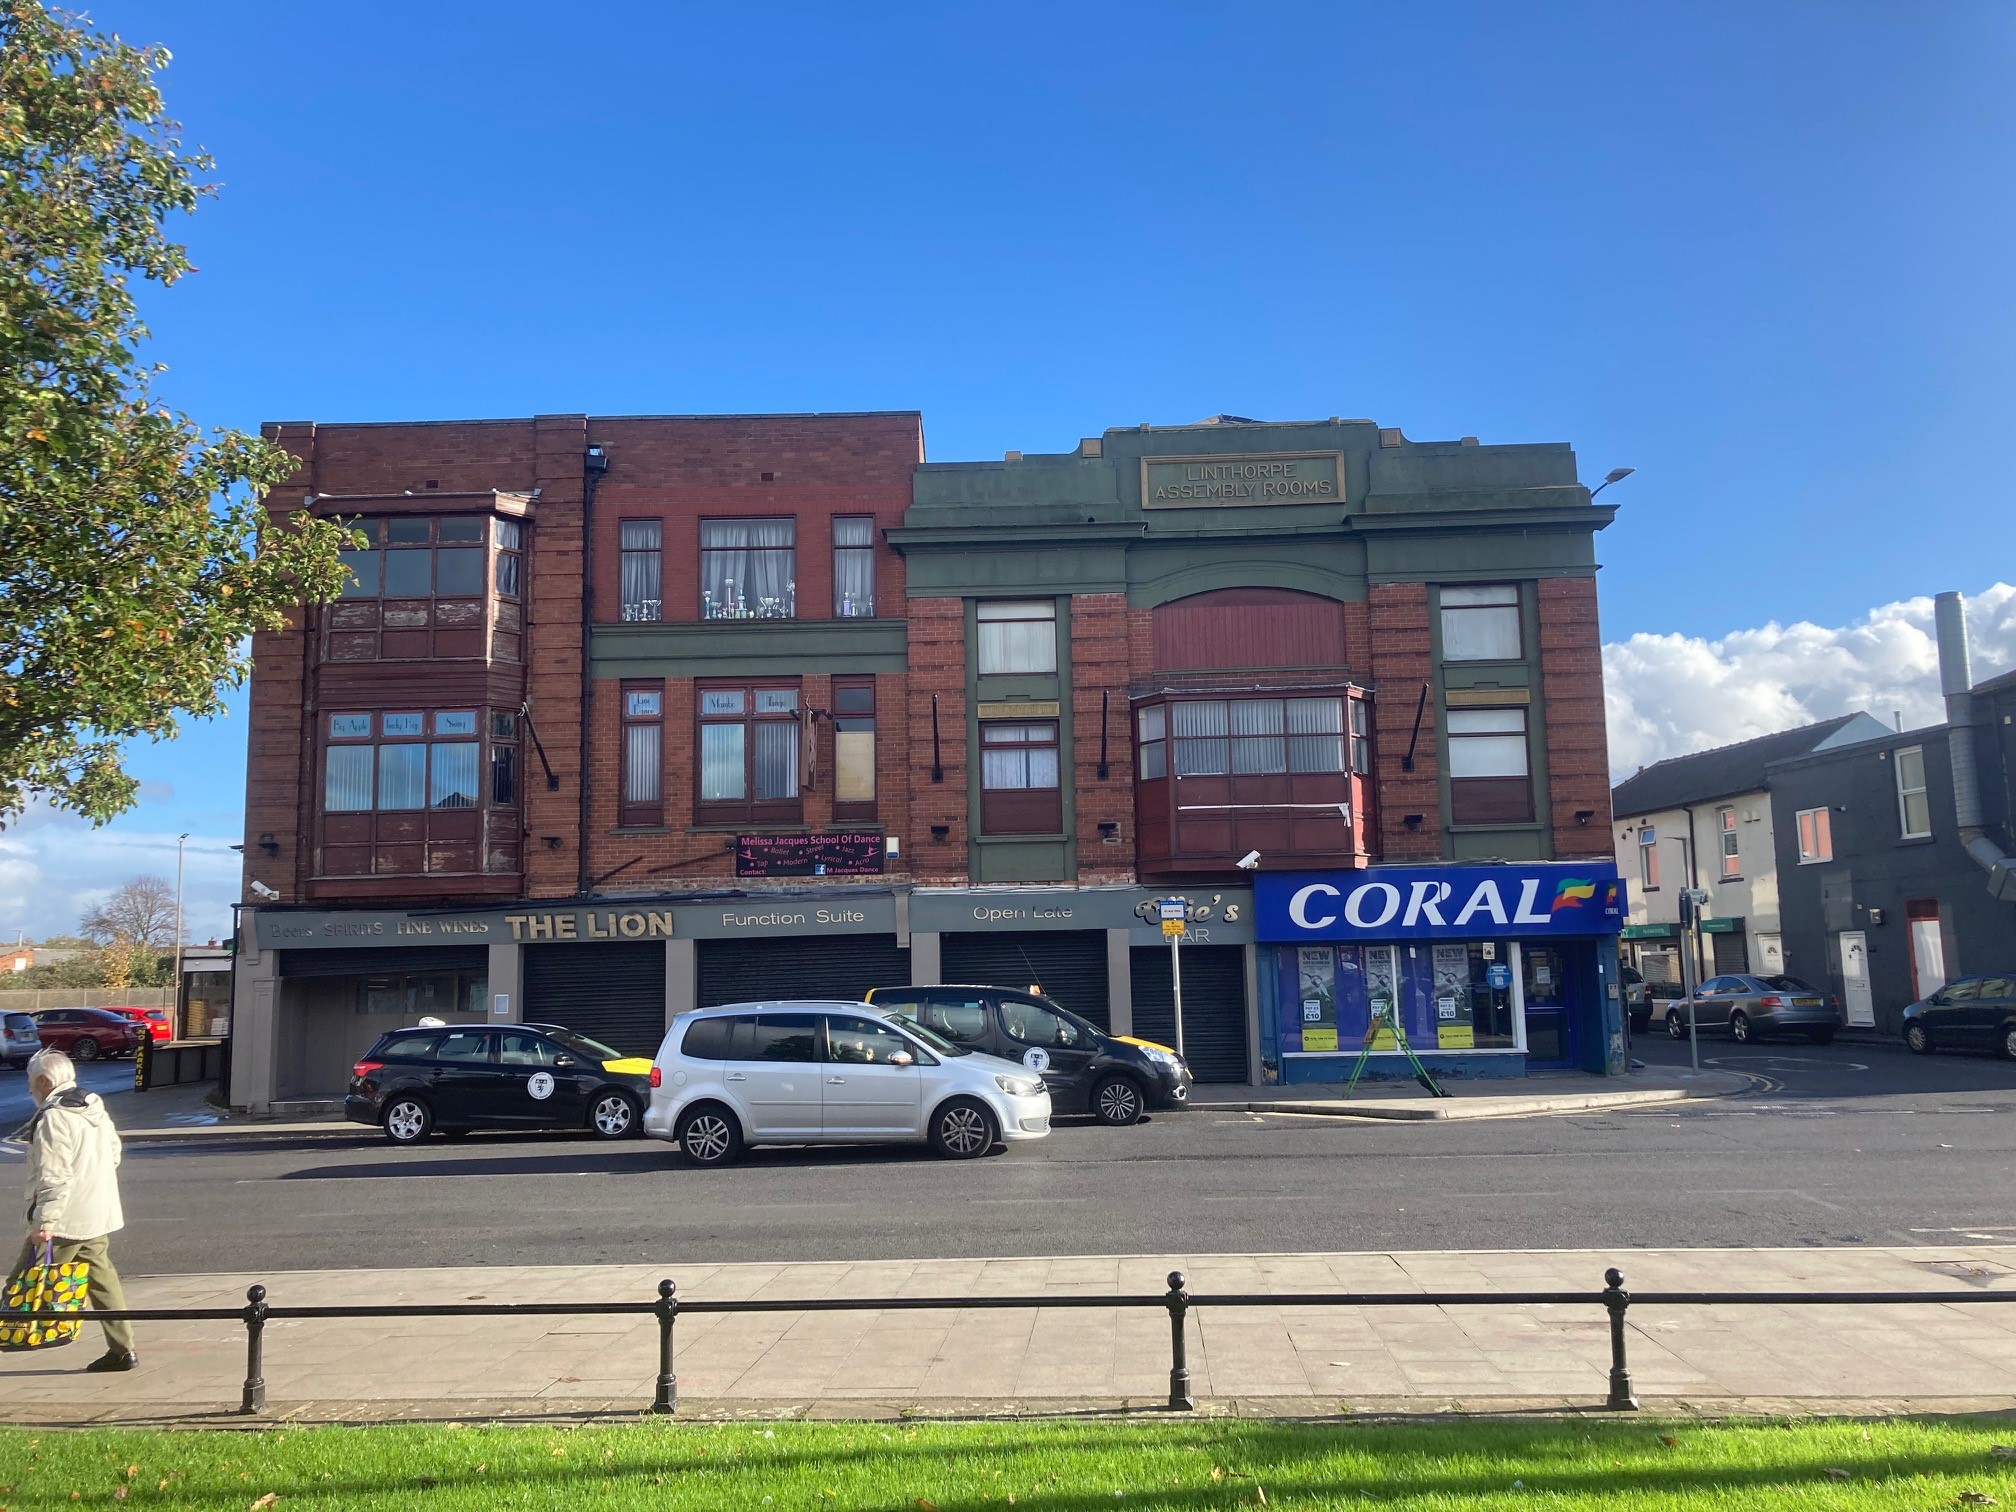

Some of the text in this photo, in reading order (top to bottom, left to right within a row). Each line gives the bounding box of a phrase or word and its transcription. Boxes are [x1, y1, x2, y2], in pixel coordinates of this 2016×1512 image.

[1187, 463, 1296, 481] LINTHORPE
[1155, 480, 1332, 499] ASSEMBLY ROOMS
[637, 694, 651, 704] Line
[711, 697, 736, 708] Mambo
[767, 695, 787, 708] Tango
[333, 719, 368, 732] Big Apple
[446, 716, 466, 729] Swing
[741, 835, 880, 847] Melissa Jacques School Of Dance
[770, 847, 790, 856] Ballet
[805, 844, 824, 855] Street
[756, 860, 768, 868] Tap
[783, 857, 808, 866] Modern
[821, 854, 843, 863] Lyrical
[855, 857, 870, 867] Acro
[835, 867, 859, 875] Jacques
[1288, 878, 1552, 930] CORAL
[973, 906, 1073, 922] Open Late
[1605, 907, 1619, 915] CORAL
[722, 909, 864, 927] Function Suite
[271, 920, 489, 938] Beers SPIRITS FINE WINES
[505, 911, 674, 940] THE LION
[1302, 950, 1330, 960] NEW
[1436, 948, 1464, 958] NEW
[138, 1029, 145, 1040] NO
[136, 1046, 144, 1087] PARKING
